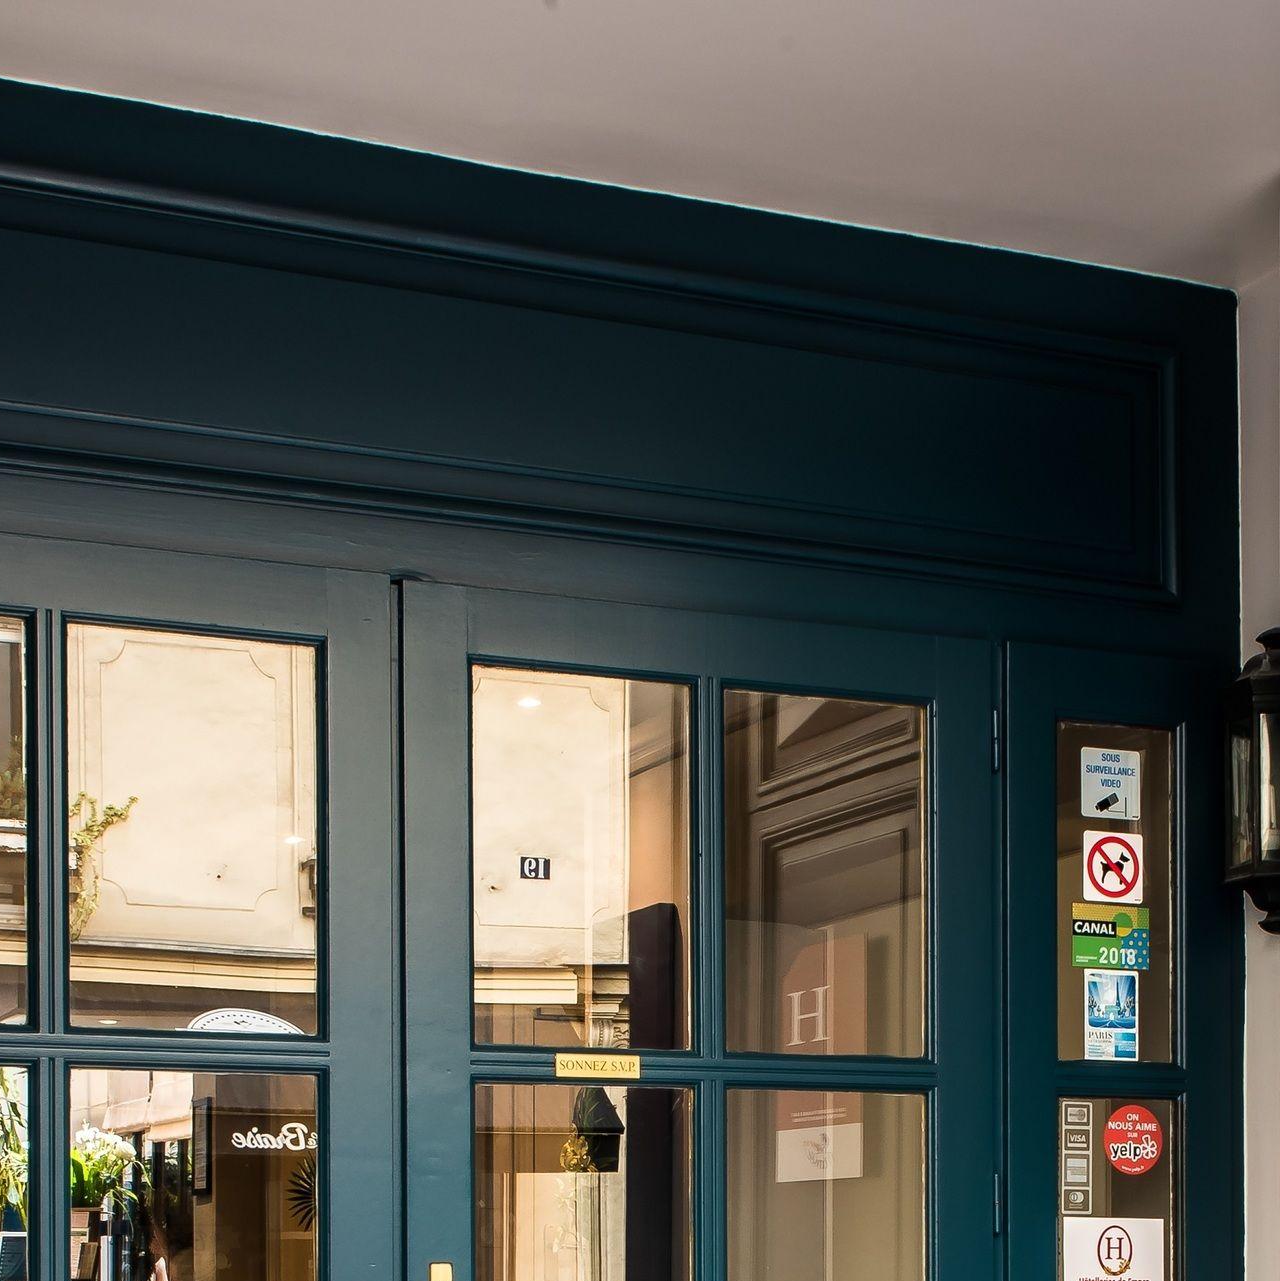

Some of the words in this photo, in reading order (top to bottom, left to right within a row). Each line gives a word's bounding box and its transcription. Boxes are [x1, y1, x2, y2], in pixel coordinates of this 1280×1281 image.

[1101, 753, 1121, 763] SOUS
[1085, 764, 1136, 777] SURVEILLANCE
[1100, 778, 1122, 788] VIDEO
[1073, 921, 1115, 935] CANAL
[1099, 947, 1136, 966] 2018
[1088, 1030, 1113, 1039] PARIS
[559, 1060, 607, 1072] SONNEZ
[1126, 1113, 1139, 1121] ON
[1108, 1121, 1133, 1131] NOUS
[1135, 1123, 1157, 1131] AIME
[1069, 1134, 1087, 1143] VISA
[1111, 1141, 1142, 1161] yelp
[1105, 1237, 1125, 1260] H
